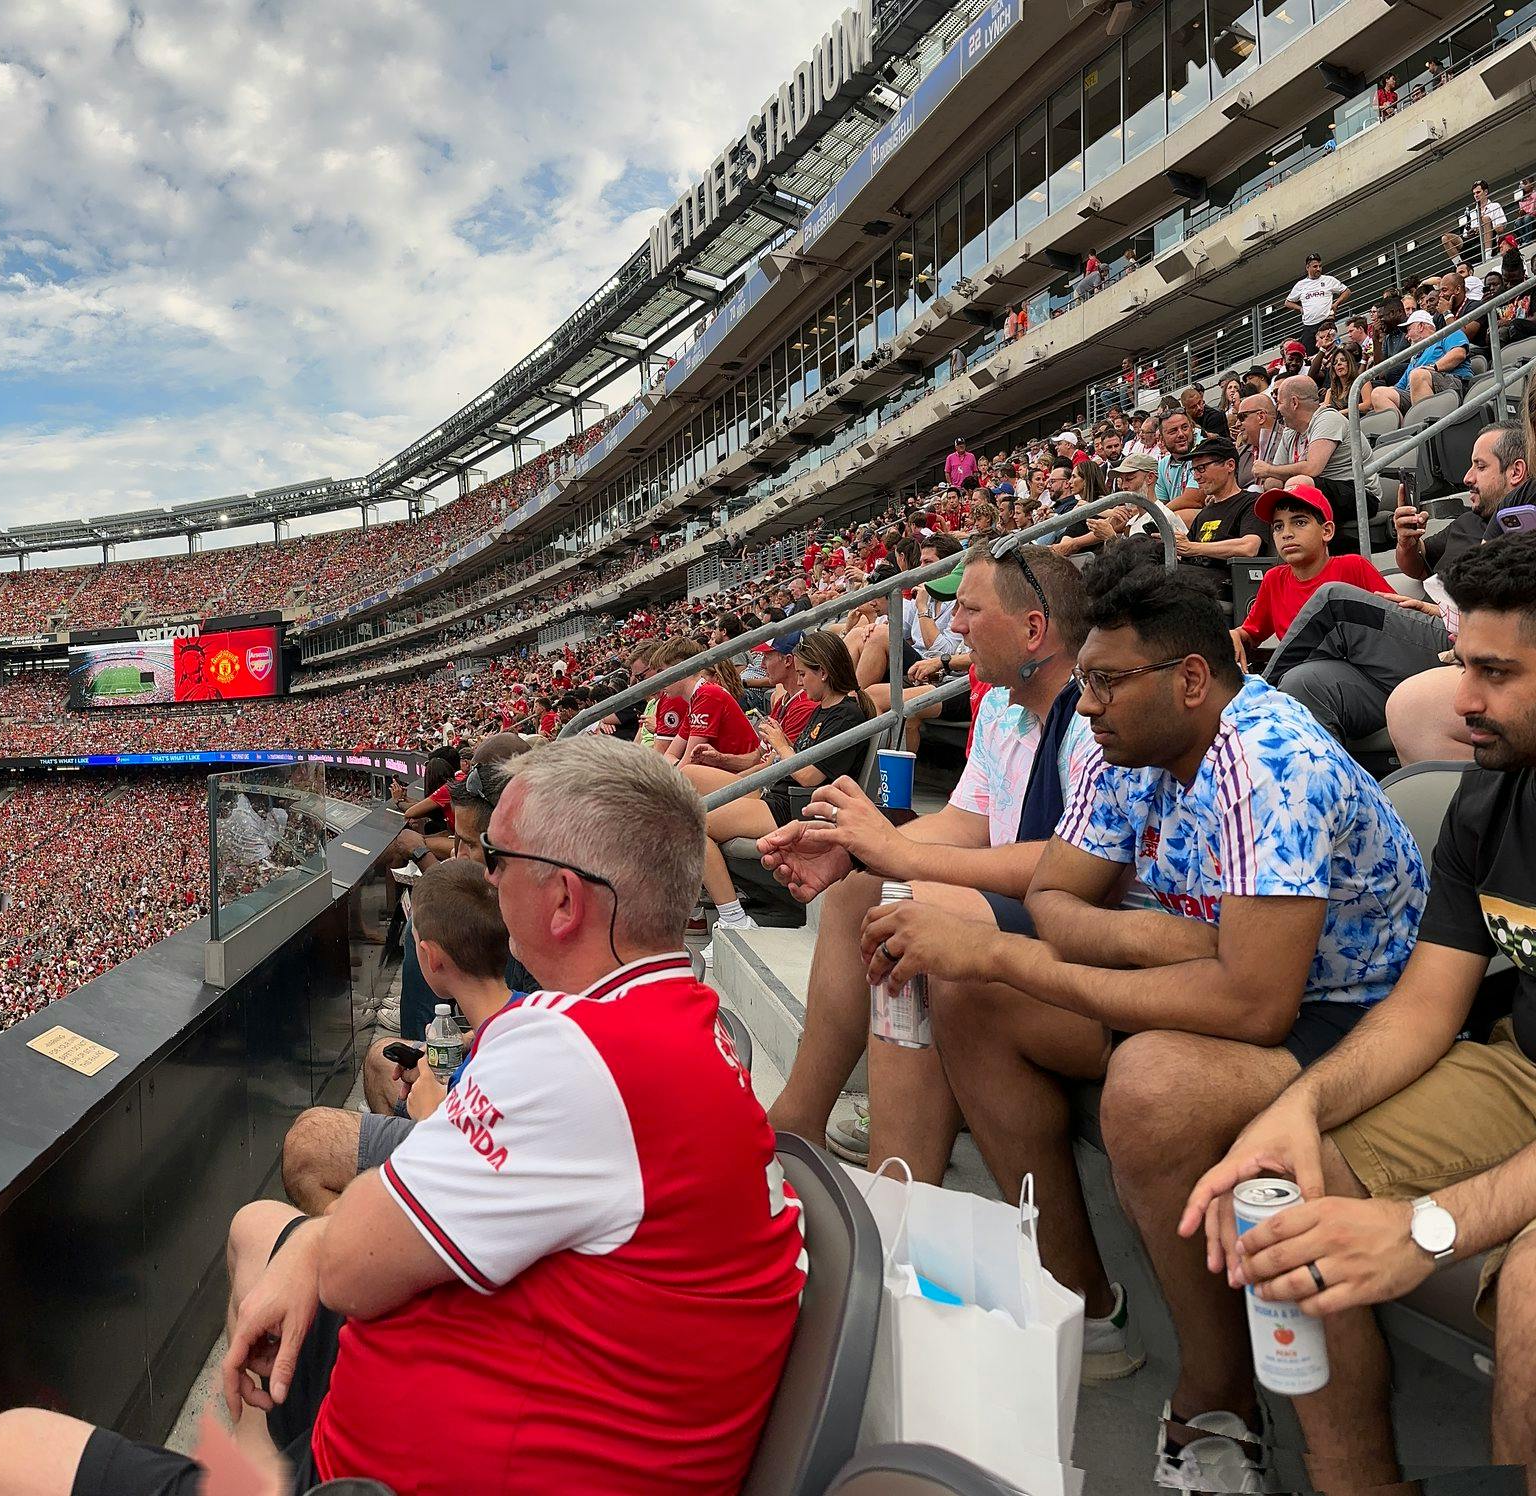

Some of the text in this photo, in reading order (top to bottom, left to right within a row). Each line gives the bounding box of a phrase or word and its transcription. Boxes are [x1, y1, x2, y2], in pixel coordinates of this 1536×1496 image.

[968, 4, 1011, 58] 22 LYNCH
[649, 0, 873, 279] METLIFE STADIUM
[813, 202, 836, 239] WEBSTER
[136, 622, 200, 643] verizon
[464, 1075, 505, 1129] VISIT
